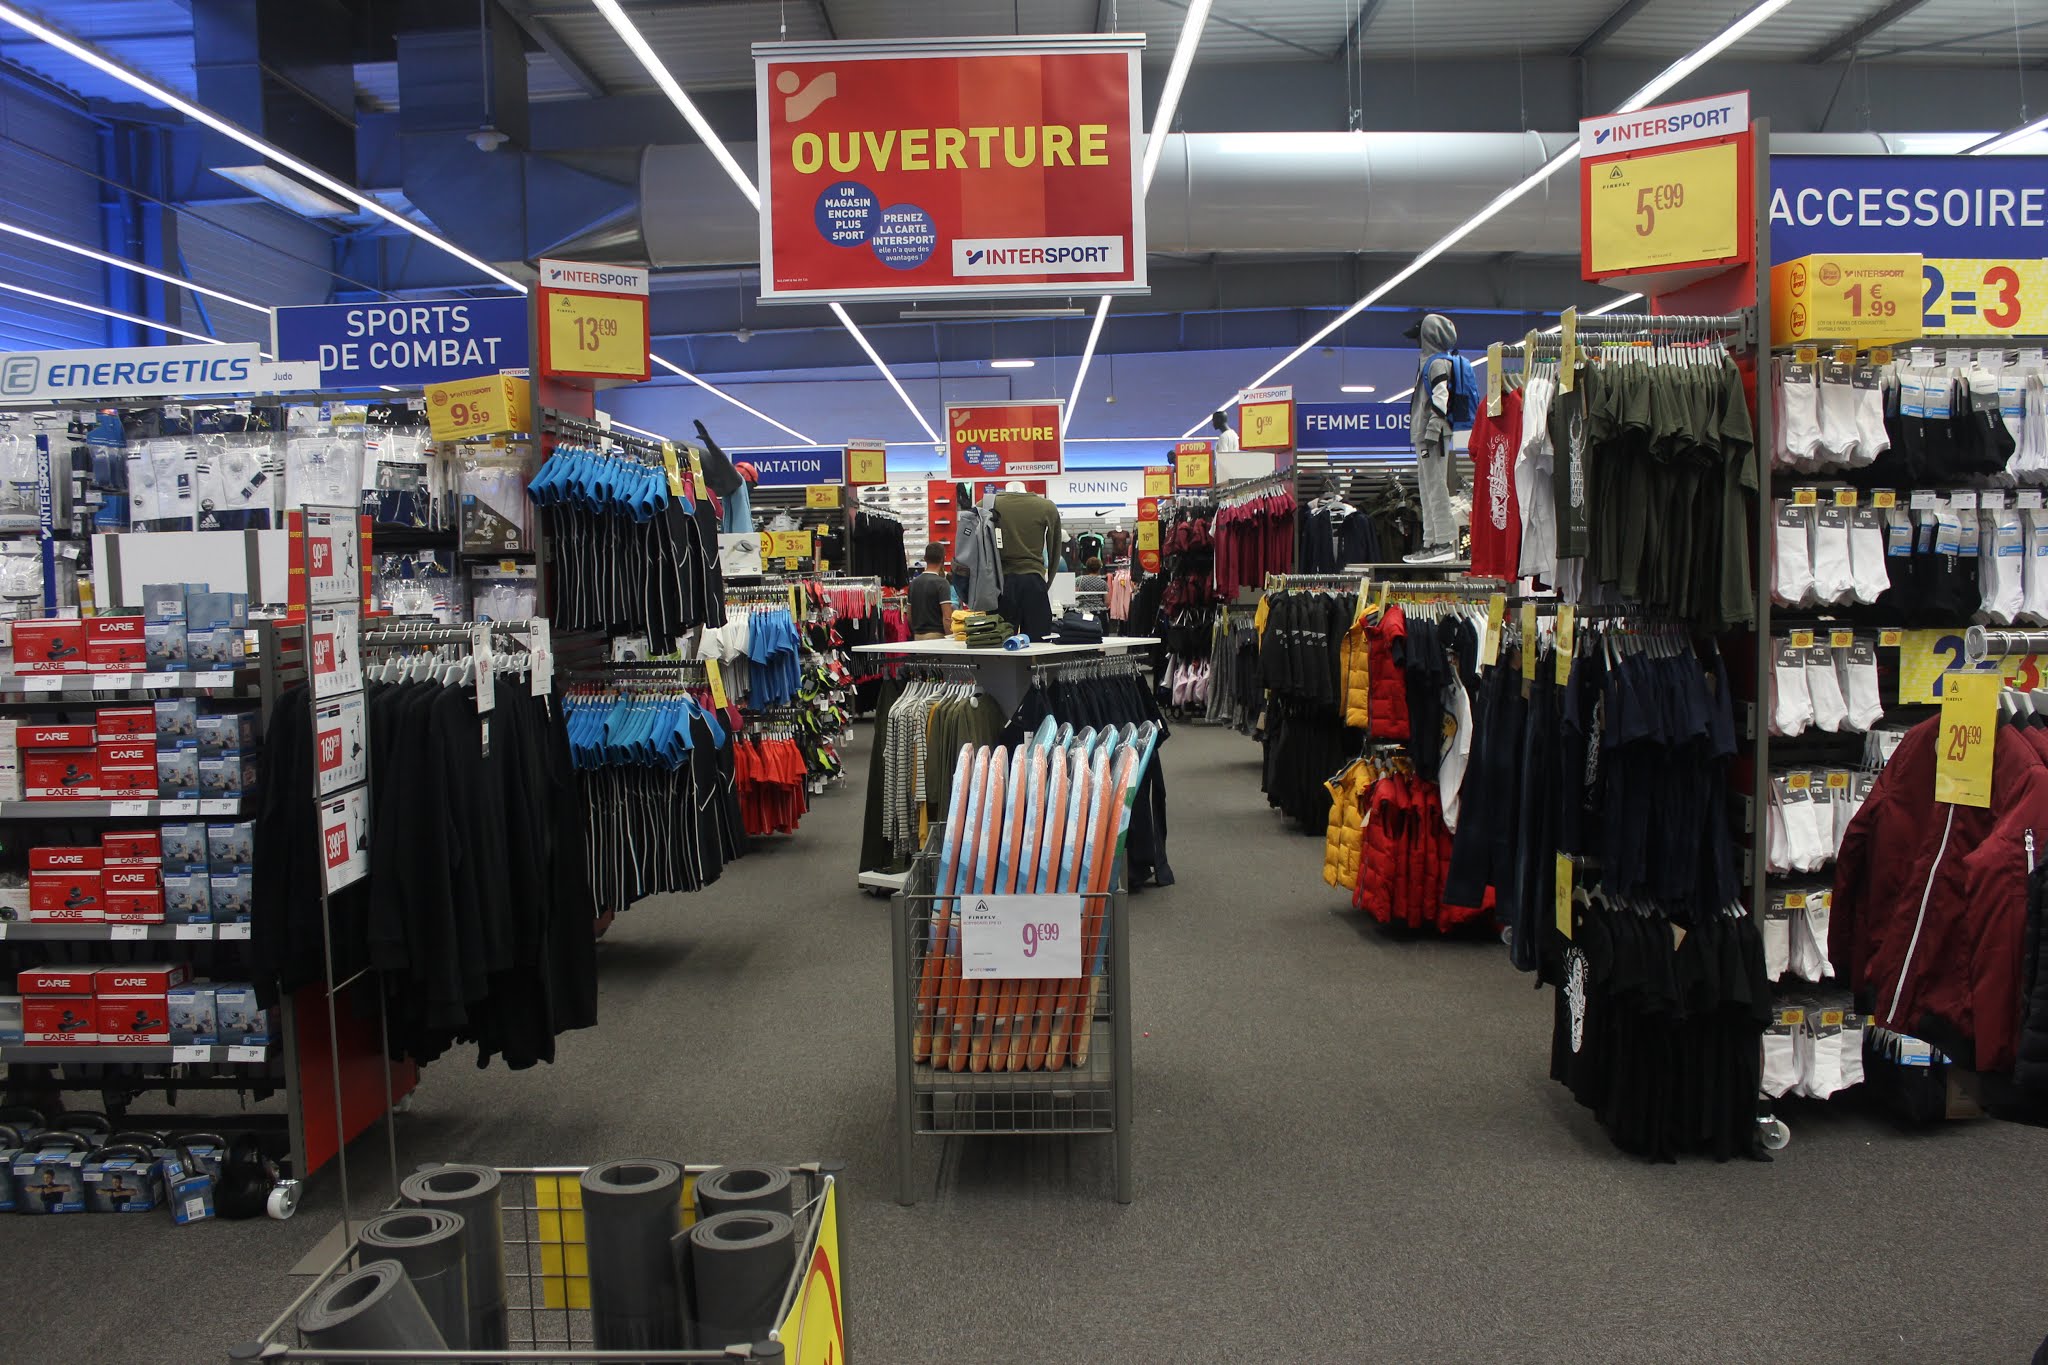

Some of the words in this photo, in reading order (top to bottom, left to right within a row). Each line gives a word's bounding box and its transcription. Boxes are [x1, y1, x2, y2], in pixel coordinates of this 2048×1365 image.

[1612, 107, 1731, 142] INTERSPORT
[791, 124, 1109, 174] OUVERTURE
[1602, 182, 1630, 190] FIREFLY
[840, 188, 855, 197] UN
[825, 199, 871, 208] MAGASIN
[1770, 187, 2048, 227] ACCESSOIRE
[828, 209, 868, 219] ENCORE
[1635, 183, 1684, 237] 5€99
[883, 213, 923, 223] PRENEZ
[835, 220, 861, 229] PLUS
[880, 226, 893, 234] LA
[895, 225, 927, 234] CARTE
[832, 230, 865, 240] SPORT
[872, 235, 935, 246] INTERSPORT
[886, 254, 918, 262] avantages
[986, 246, 1109, 265] INTERSPORT
[563, 270, 638, 286] INTERSPORT
[1854, 269, 1904, 278] INTERSPORT
[346, 306, 470, 337] SPORTS
[574, 317, 617, 351] 13€99
[320, 344, 359, 371] DE
[369, 338, 502, 369] COMBAT
[48, 358, 250, 386] ENERGETICS
[273, 372, 293, 381] Judo
[1249, 390, 1287, 399] INTERSPORT
[1306, 415, 1369, 430] FEMME
[956, 427, 1053, 443] OUVERTURE
[1180, 443, 1205, 453] promo
[754, 460, 820, 473] NATATION
[38, 448, 52, 525] INTERSPORT
[1070, 482, 1128, 493] RUNNING
[100, 623, 135, 632] CARE
[32, 661, 65, 670] CARE
[105, 662, 131, 670] CARE
[35, 732, 70, 741] CARE
[1947, 725, 1982, 761] 29€99
[110, 750, 144, 759] CARE
[46, 788, 79, 796] CARE
[49, 855, 84, 864] CARE
[112, 874, 145, 883] CARE
[50, 910, 83, 918] CARE
[1022, 923, 1059, 957] 9€99
[37, 979, 71, 988] CARE
[114, 978, 147, 987] CARE
[117, 1034, 150, 1042] CARE
